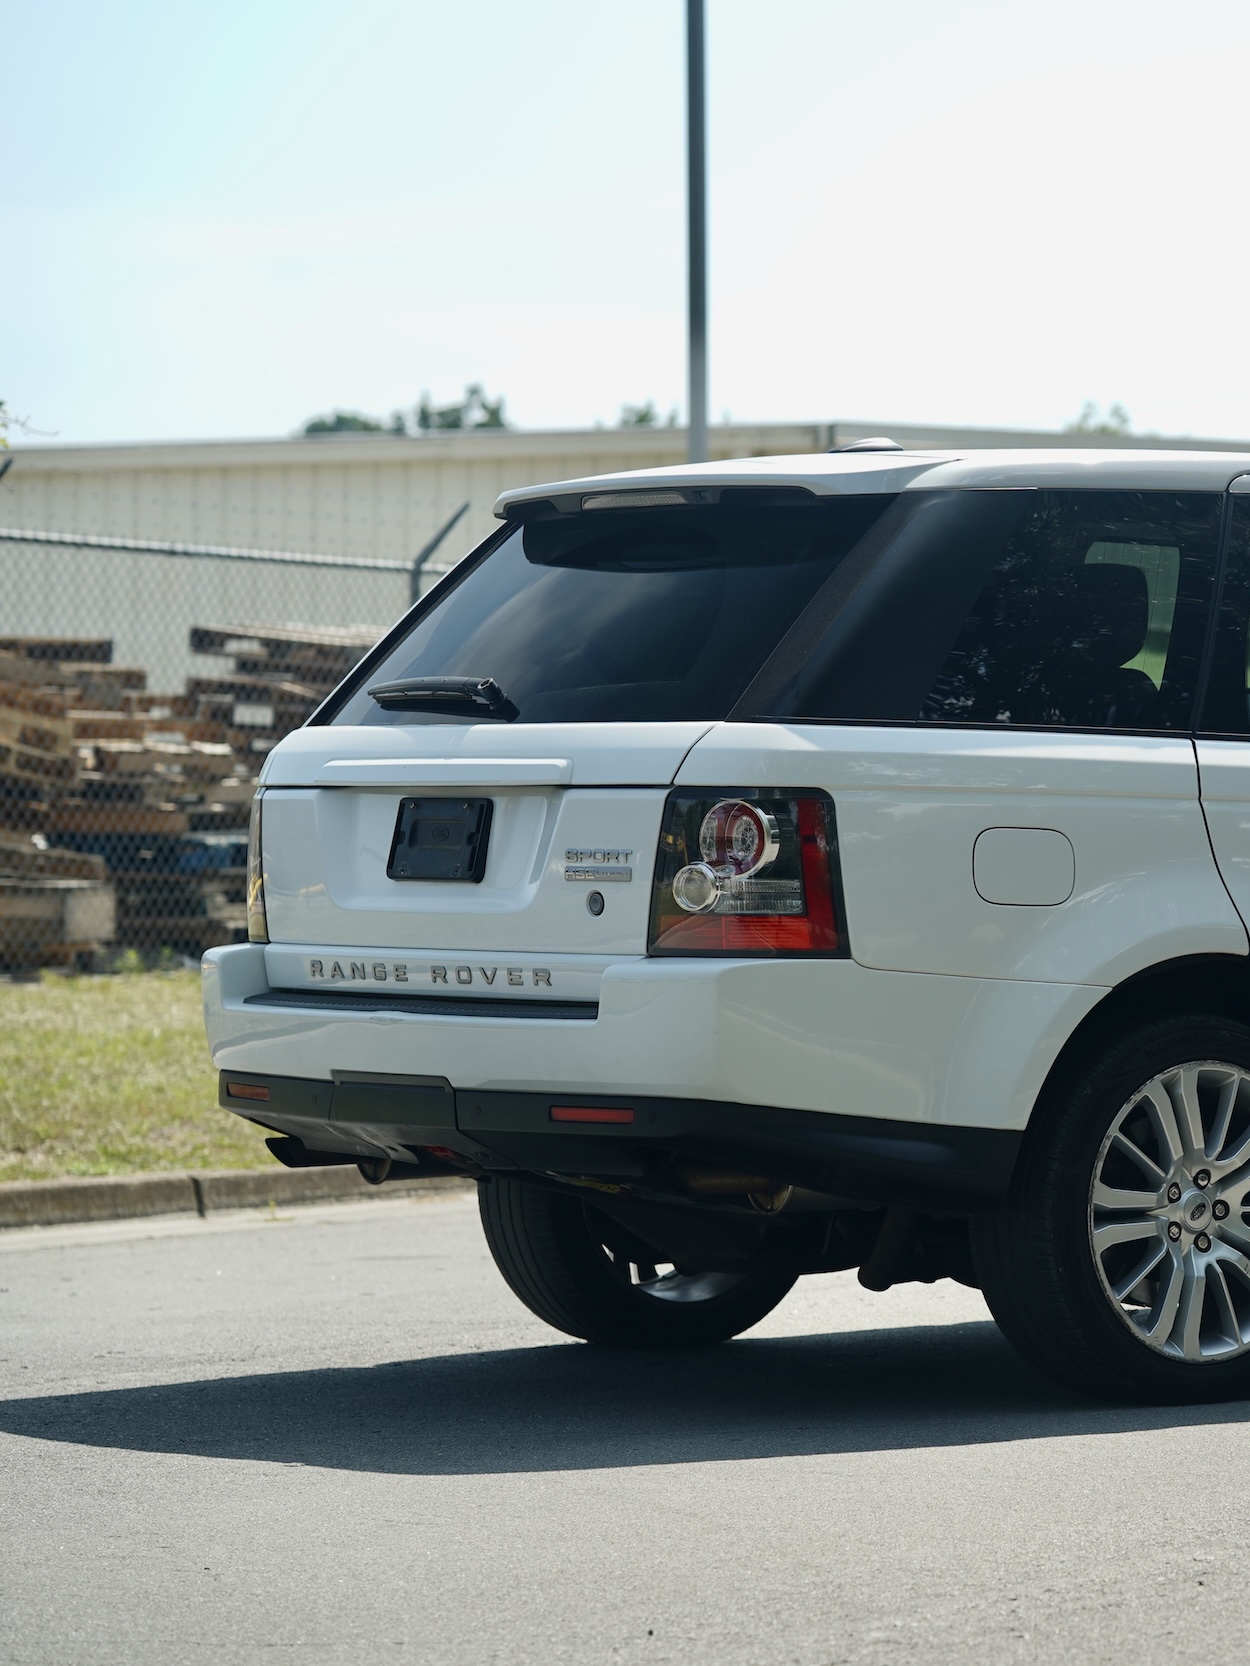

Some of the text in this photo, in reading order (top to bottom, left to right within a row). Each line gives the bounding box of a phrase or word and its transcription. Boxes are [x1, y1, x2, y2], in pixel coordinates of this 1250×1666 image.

[565, 848, 633, 863] SPORT
[565, 868, 596, 879] HSE
[310, 959, 553, 987] RANGE ROVER
